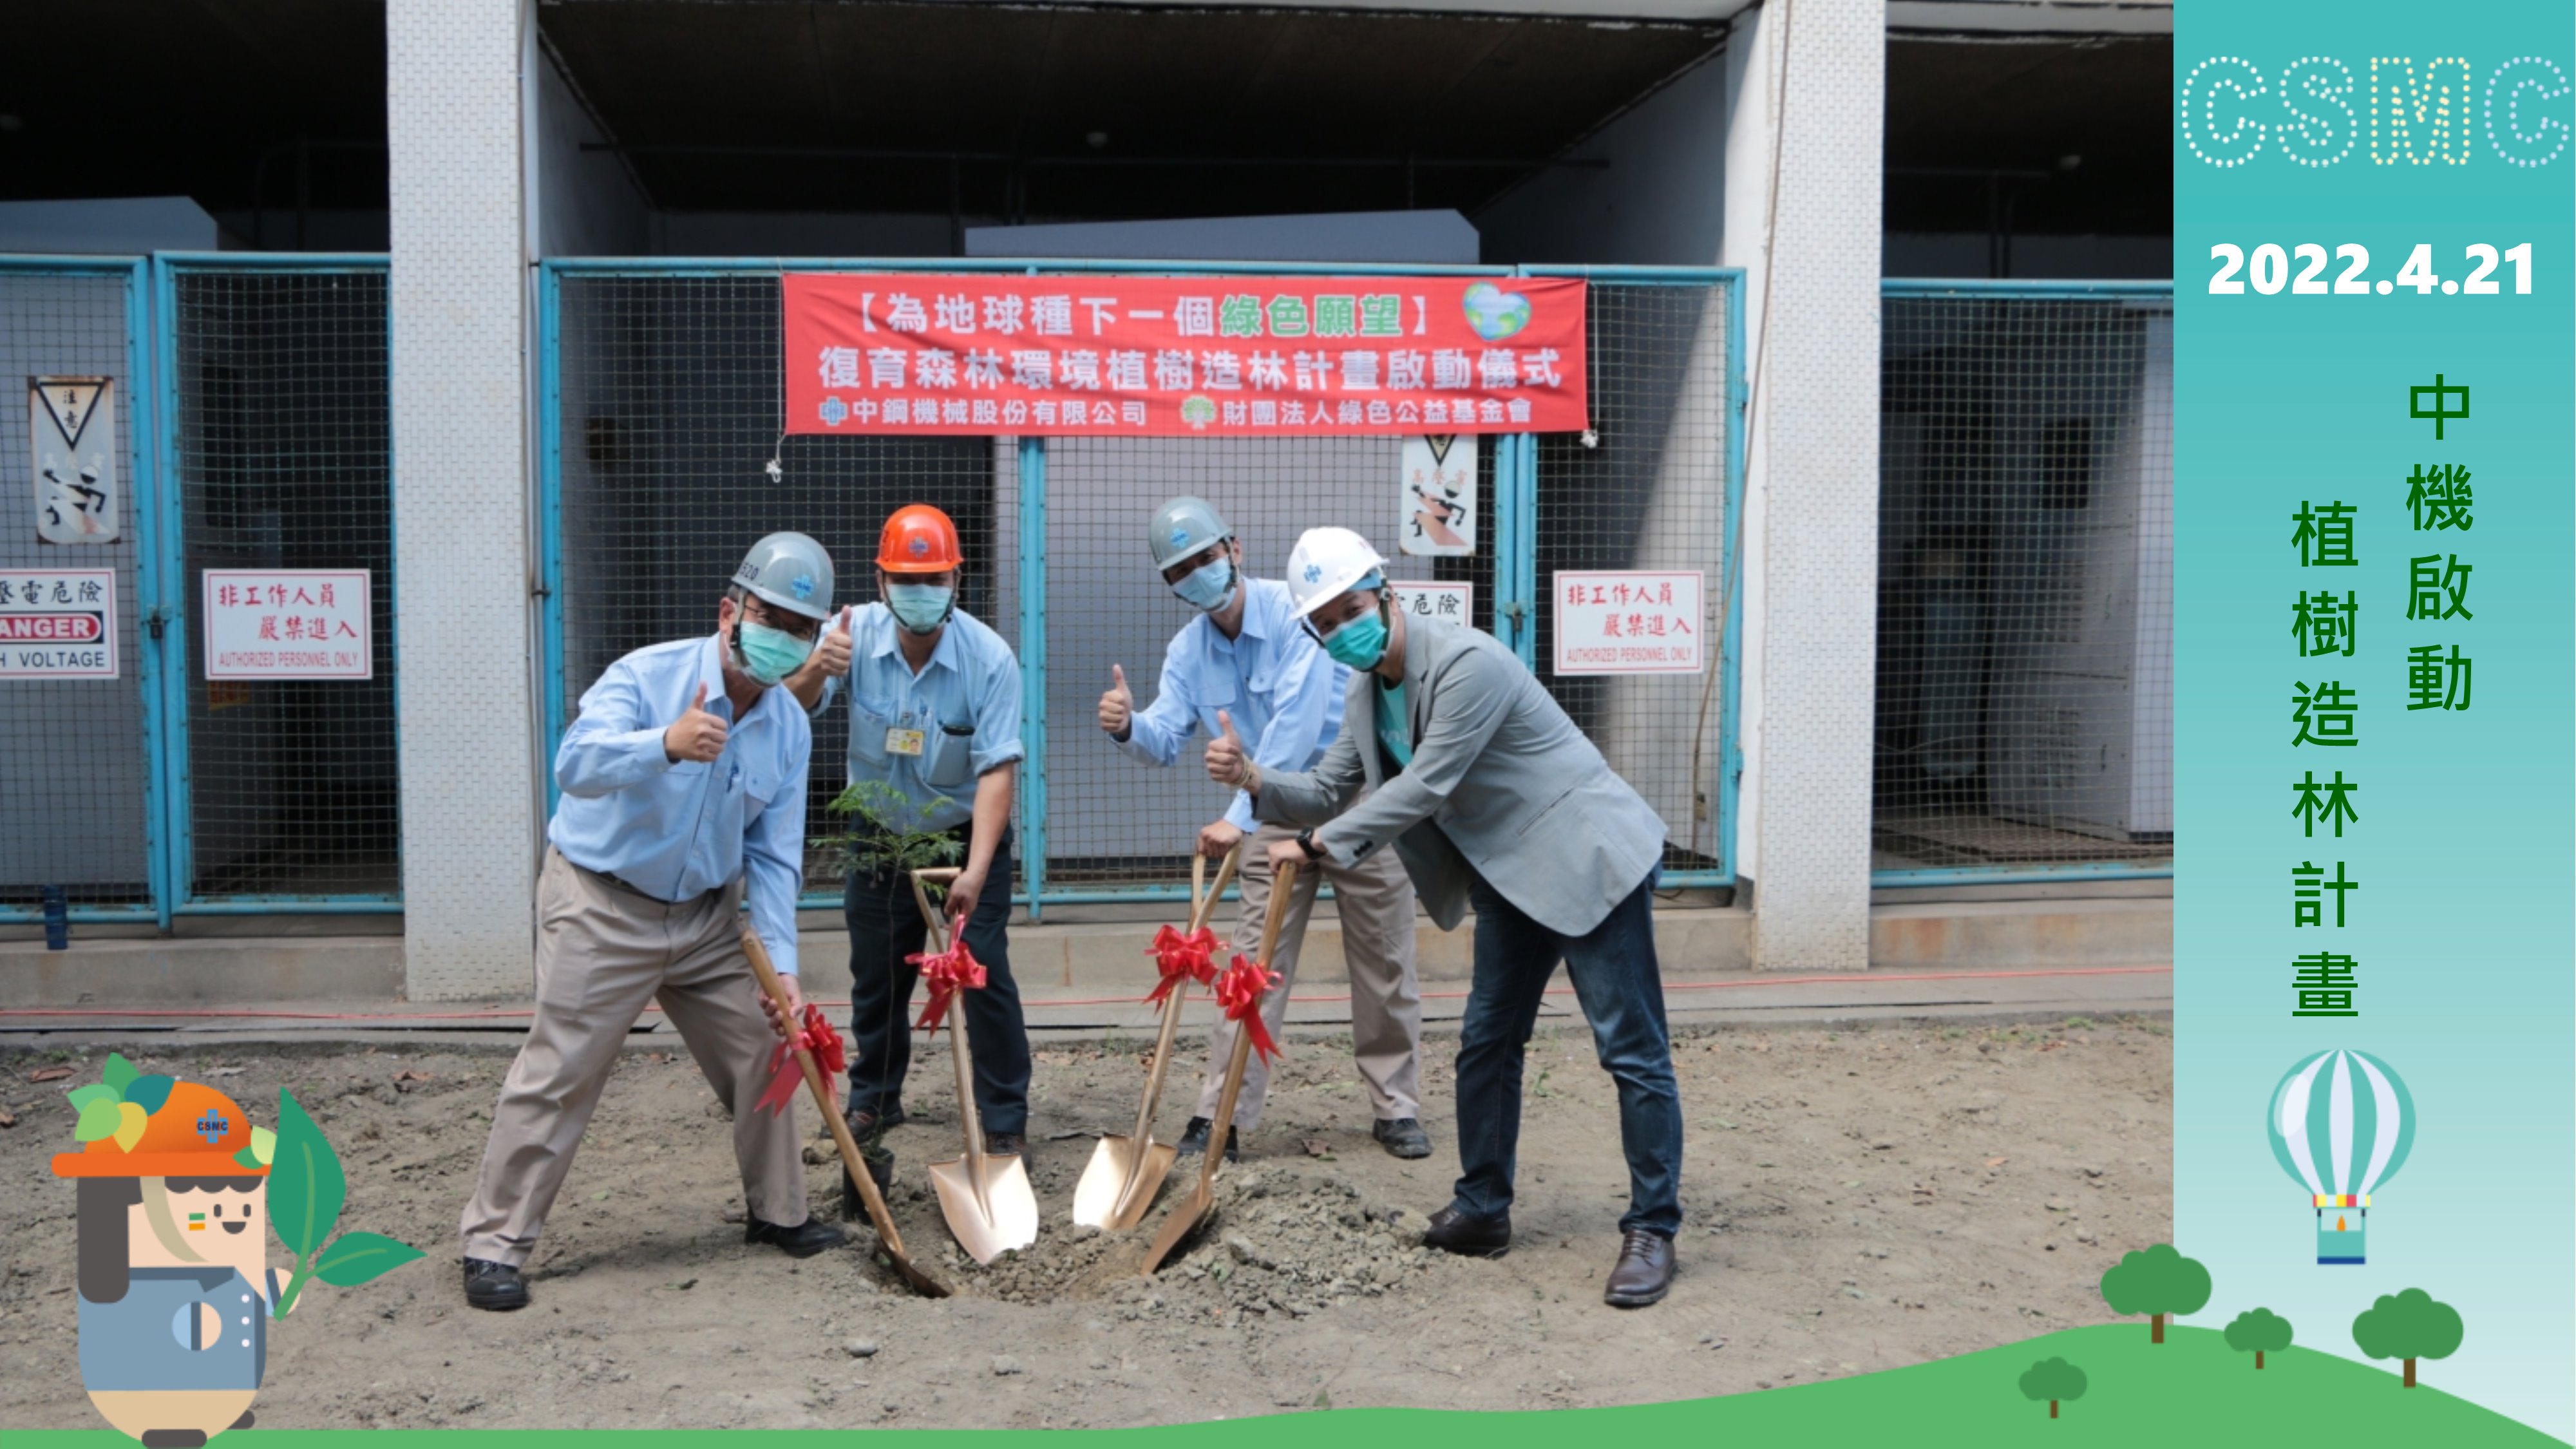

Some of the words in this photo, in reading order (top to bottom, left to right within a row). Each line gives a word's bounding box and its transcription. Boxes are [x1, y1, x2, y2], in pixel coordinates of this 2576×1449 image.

[819, 346, 1561, 391] 復育森林環境植樹造林計畫啟動儀式
[853, 398, 1146, 425] 中鋼機械股份有限公司
[1223, 397, 1532, 426] 財團法人綠色公益基金會
[218, 583, 335, 608] 非工作人員
[1567, 582, 1672, 607] 非工作人員
[259, 615, 357, 641] 嚴禁進入
[1603, 613, 1692, 638] 嚴禁進入
[19, 652, 105, 668] VOLTAGE
[219, 651, 274, 667] AUTHORIZED
[278, 651, 331, 667] PERSONNEL
[335, 651, 358, 667] ONLY
[1567, 647, 1617, 662] AUTHORIZED
[1620, 647, 1668, 662] PERSONNEL
[1671, 647, 1692, 661] ONLY
